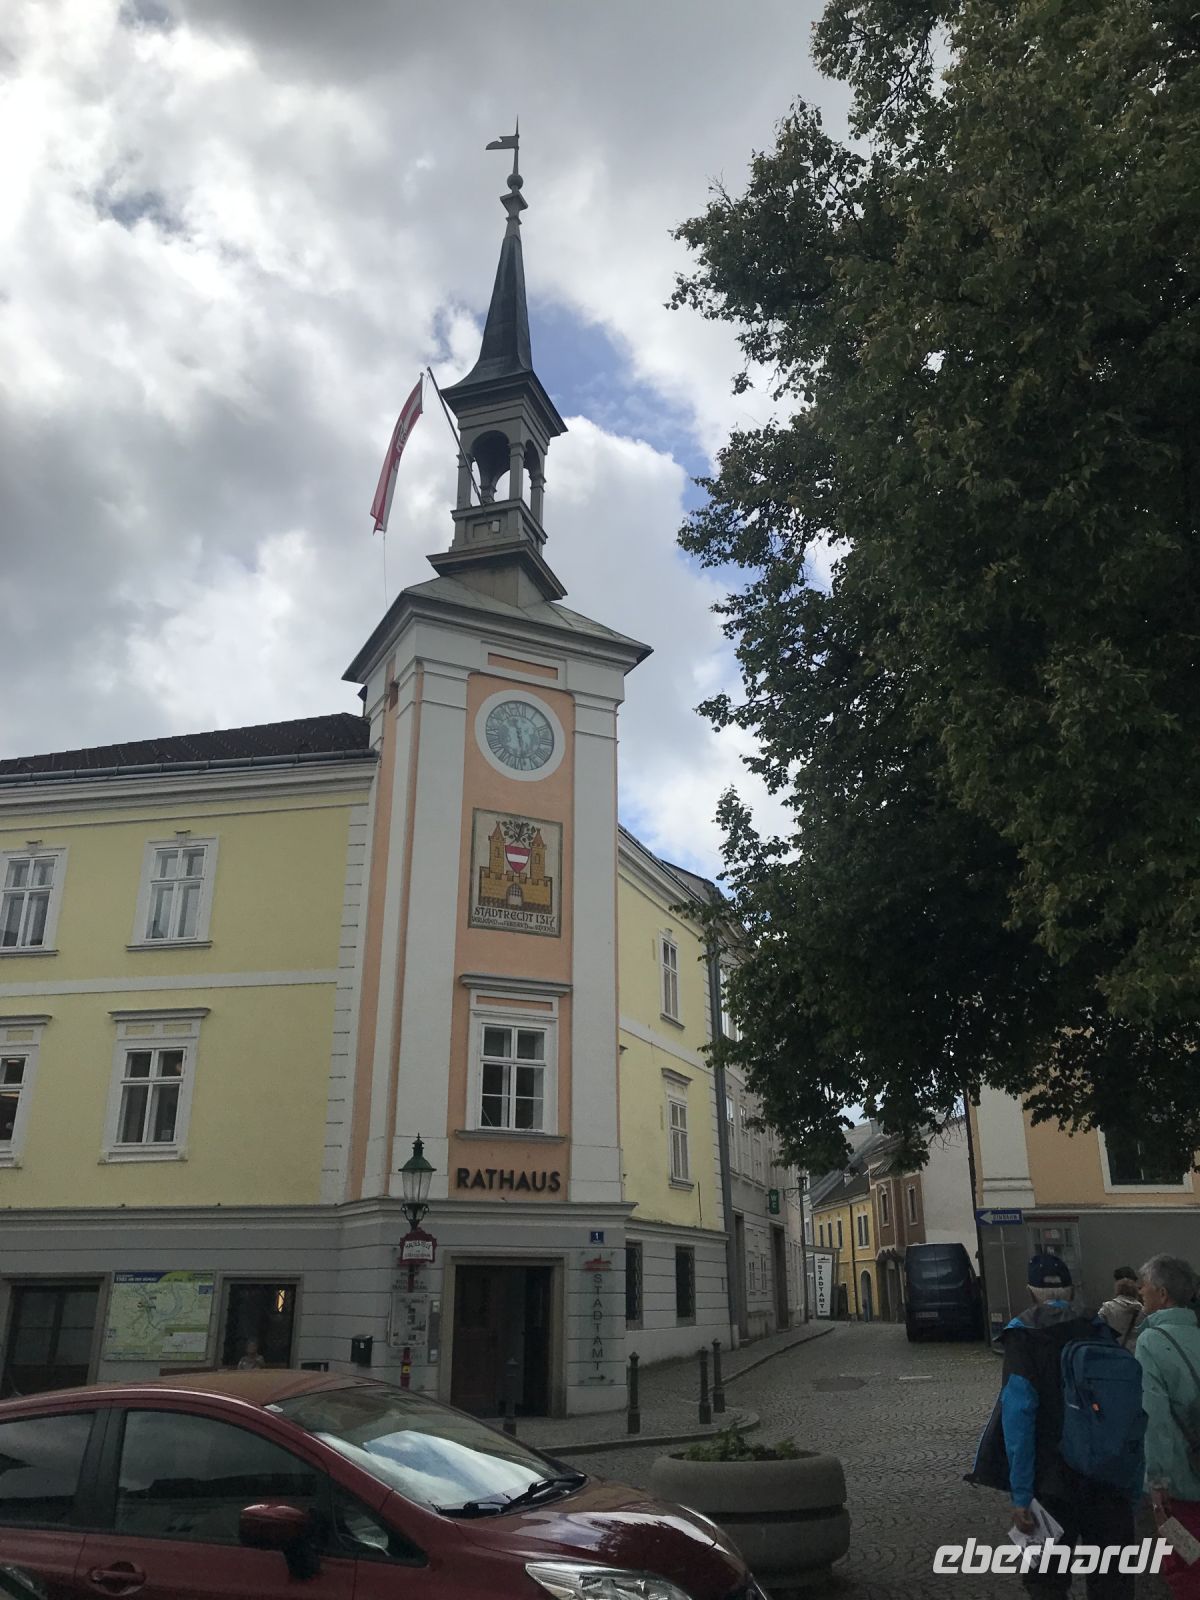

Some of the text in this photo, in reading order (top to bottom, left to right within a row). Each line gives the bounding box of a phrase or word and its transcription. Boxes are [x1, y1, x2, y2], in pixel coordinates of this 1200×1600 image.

[456, 1167, 561, 1192] RATHAUS
[817, 1264, 826, 1309] STADTAMT
[592, 1273, 603, 1371] STADTAMT
